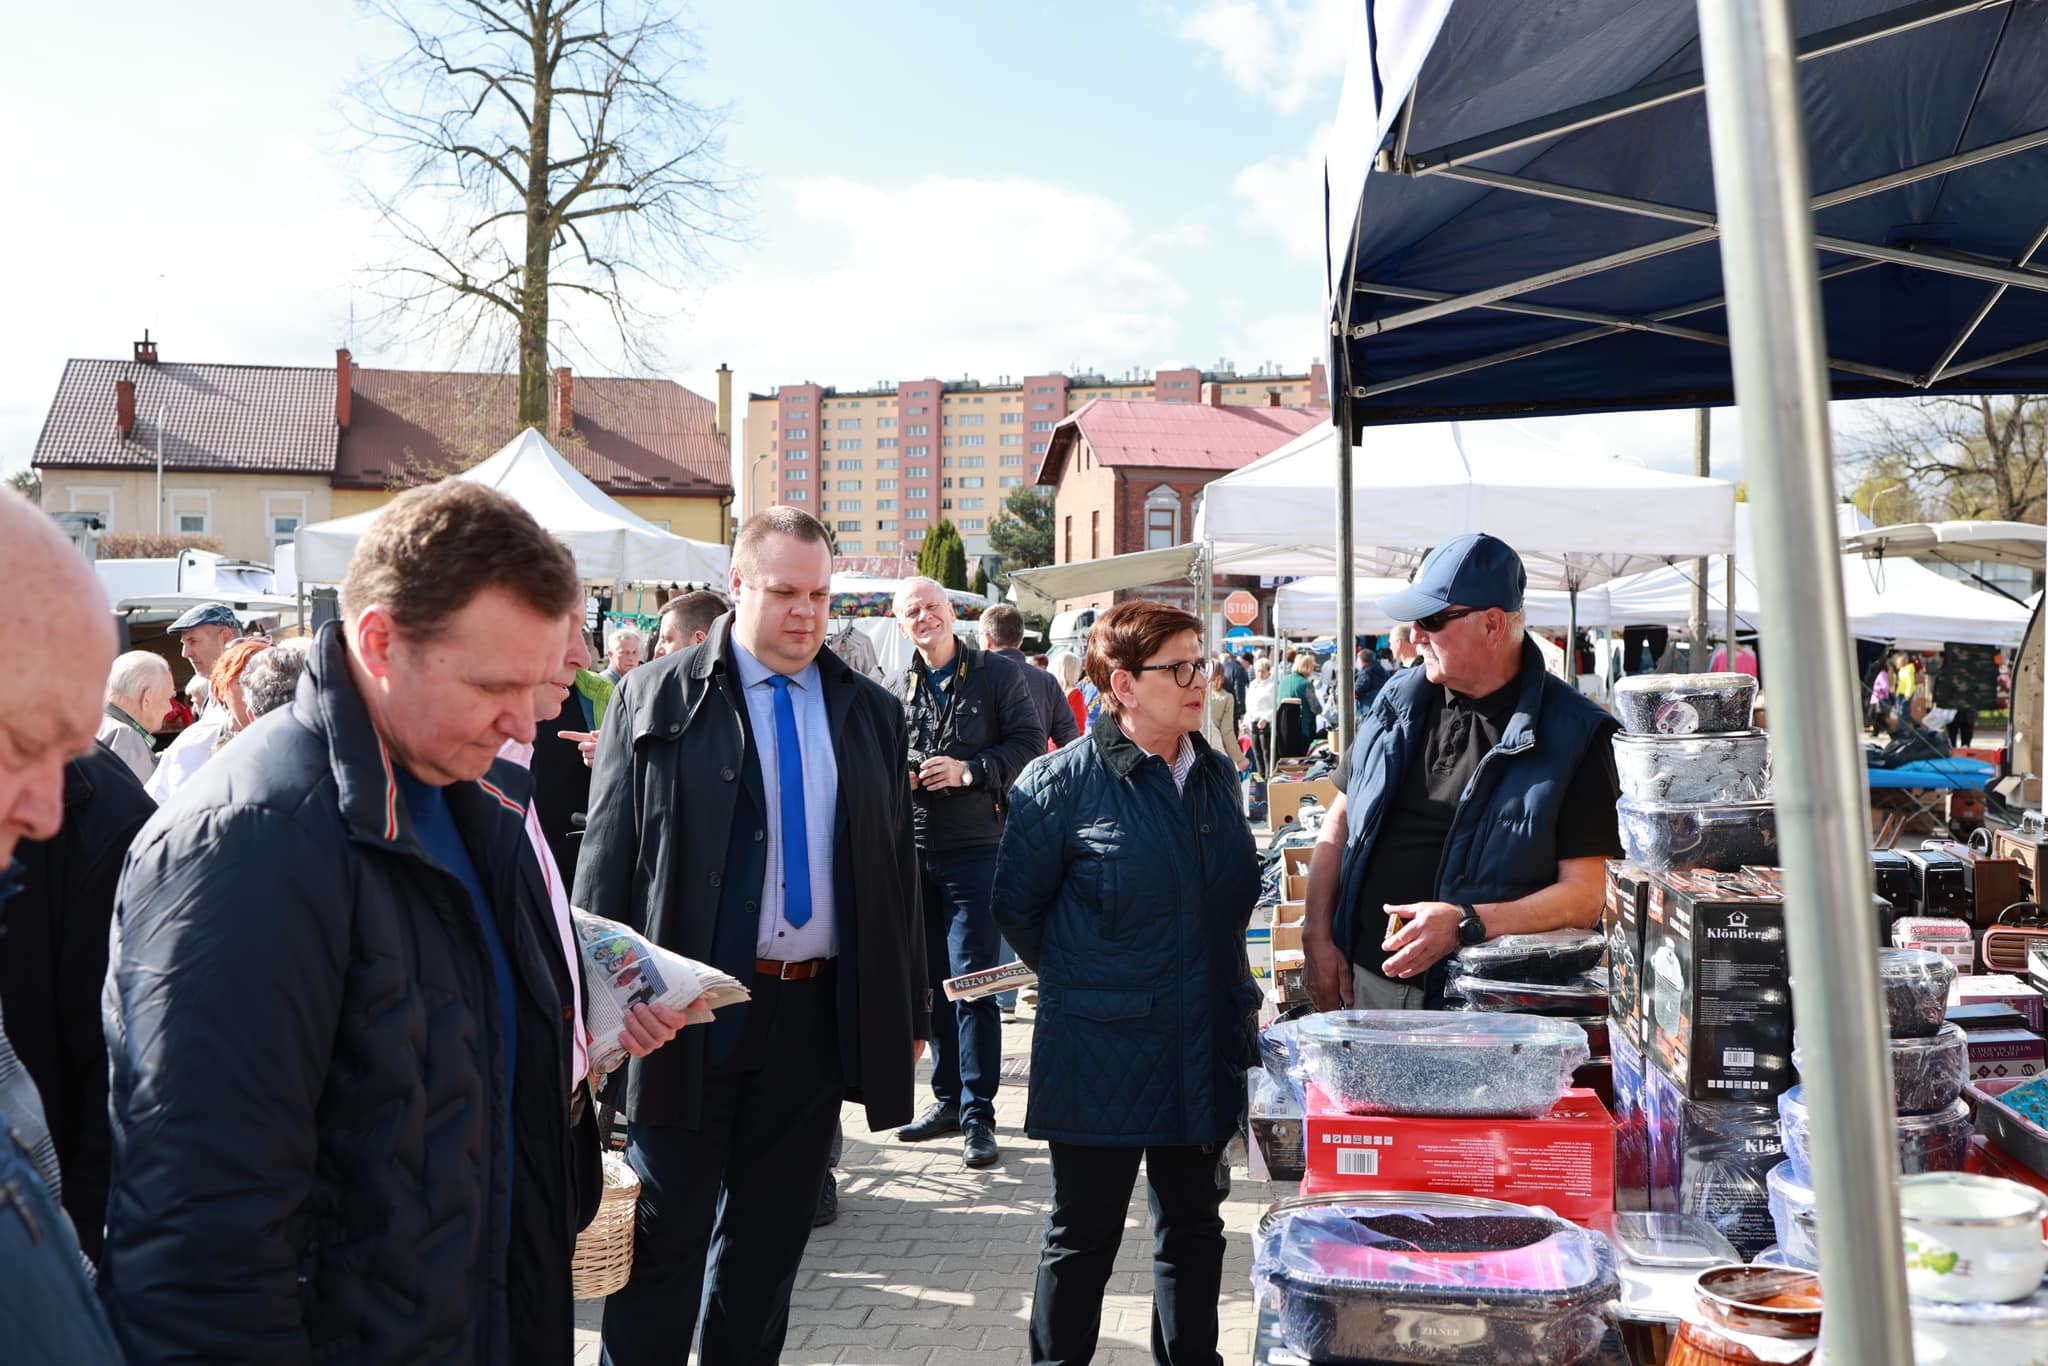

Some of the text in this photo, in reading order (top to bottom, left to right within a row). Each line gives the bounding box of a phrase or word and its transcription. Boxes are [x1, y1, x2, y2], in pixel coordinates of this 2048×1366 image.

[1228, 602, 1254, 614] STOP
[1707, 927, 1771, 942] KlönBerg
[954, 975, 993, 990] RAZEM
[1422, 1327, 1460, 1337] ZILNER
